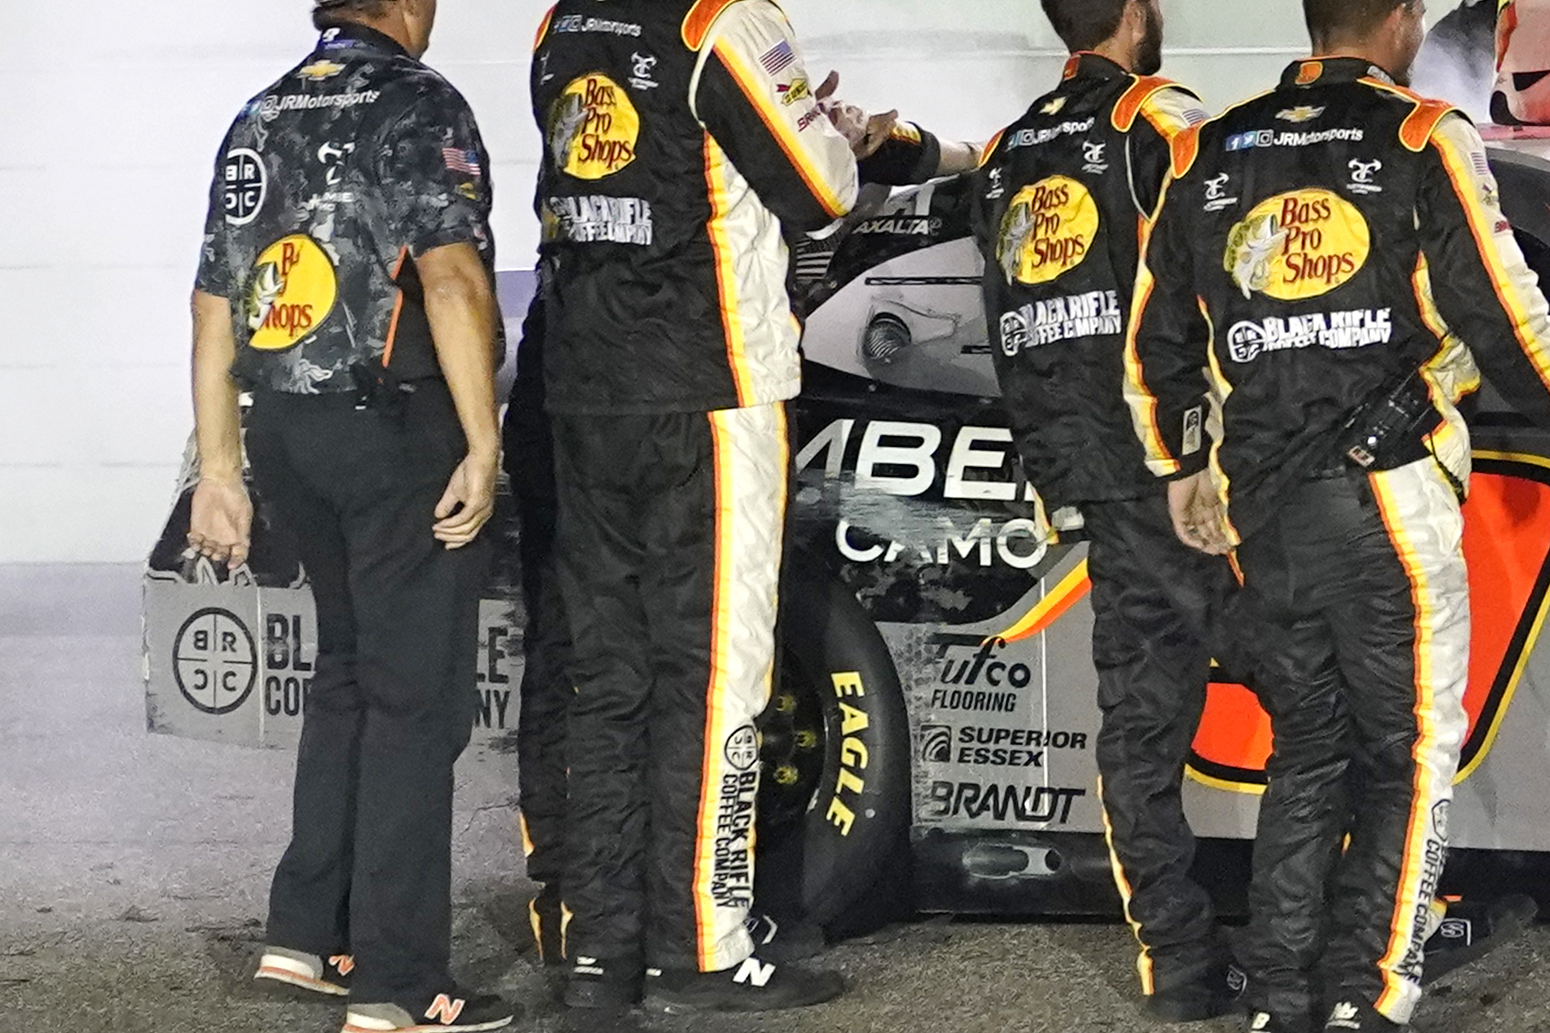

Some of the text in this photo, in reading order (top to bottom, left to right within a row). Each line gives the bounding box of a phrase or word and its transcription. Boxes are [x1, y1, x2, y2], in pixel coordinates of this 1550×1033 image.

[585, 78, 617, 107] Bass
[584, 108, 612, 134] Pro
[578, 133, 633, 168] Shops
[1031, 184, 1070, 215] Bass
[1279, 196, 1332, 228] Bass
[852, 219, 929, 235] AXALTA
[1033, 213, 1060, 240] Pro
[1282, 226, 1323, 256] Pro
[1032, 234, 1085, 267] Shops
[1282, 251, 1356, 285] Shops
[1066, 289, 1120, 320] RIFLE
[1318, 327, 1391, 349] COMPANY
[835, 517, 1049, 569] CAMO
[924, 632, 1032, 689] Tufco
[930, 689, 1017, 713] FLOORING
[826, 671, 869, 837] EAGLE
[957, 726, 1088, 750] SUPERIOR
[956, 747, 1044, 768] ESSEX
[731, 770, 758, 843] BLACK
[930, 781, 1086, 824] BRANDT
[710, 773, 738, 908] COFFEE COMPANY
[729, 848, 751, 910] RIFLE
[1418, 839, 1441, 902] COFFEE
